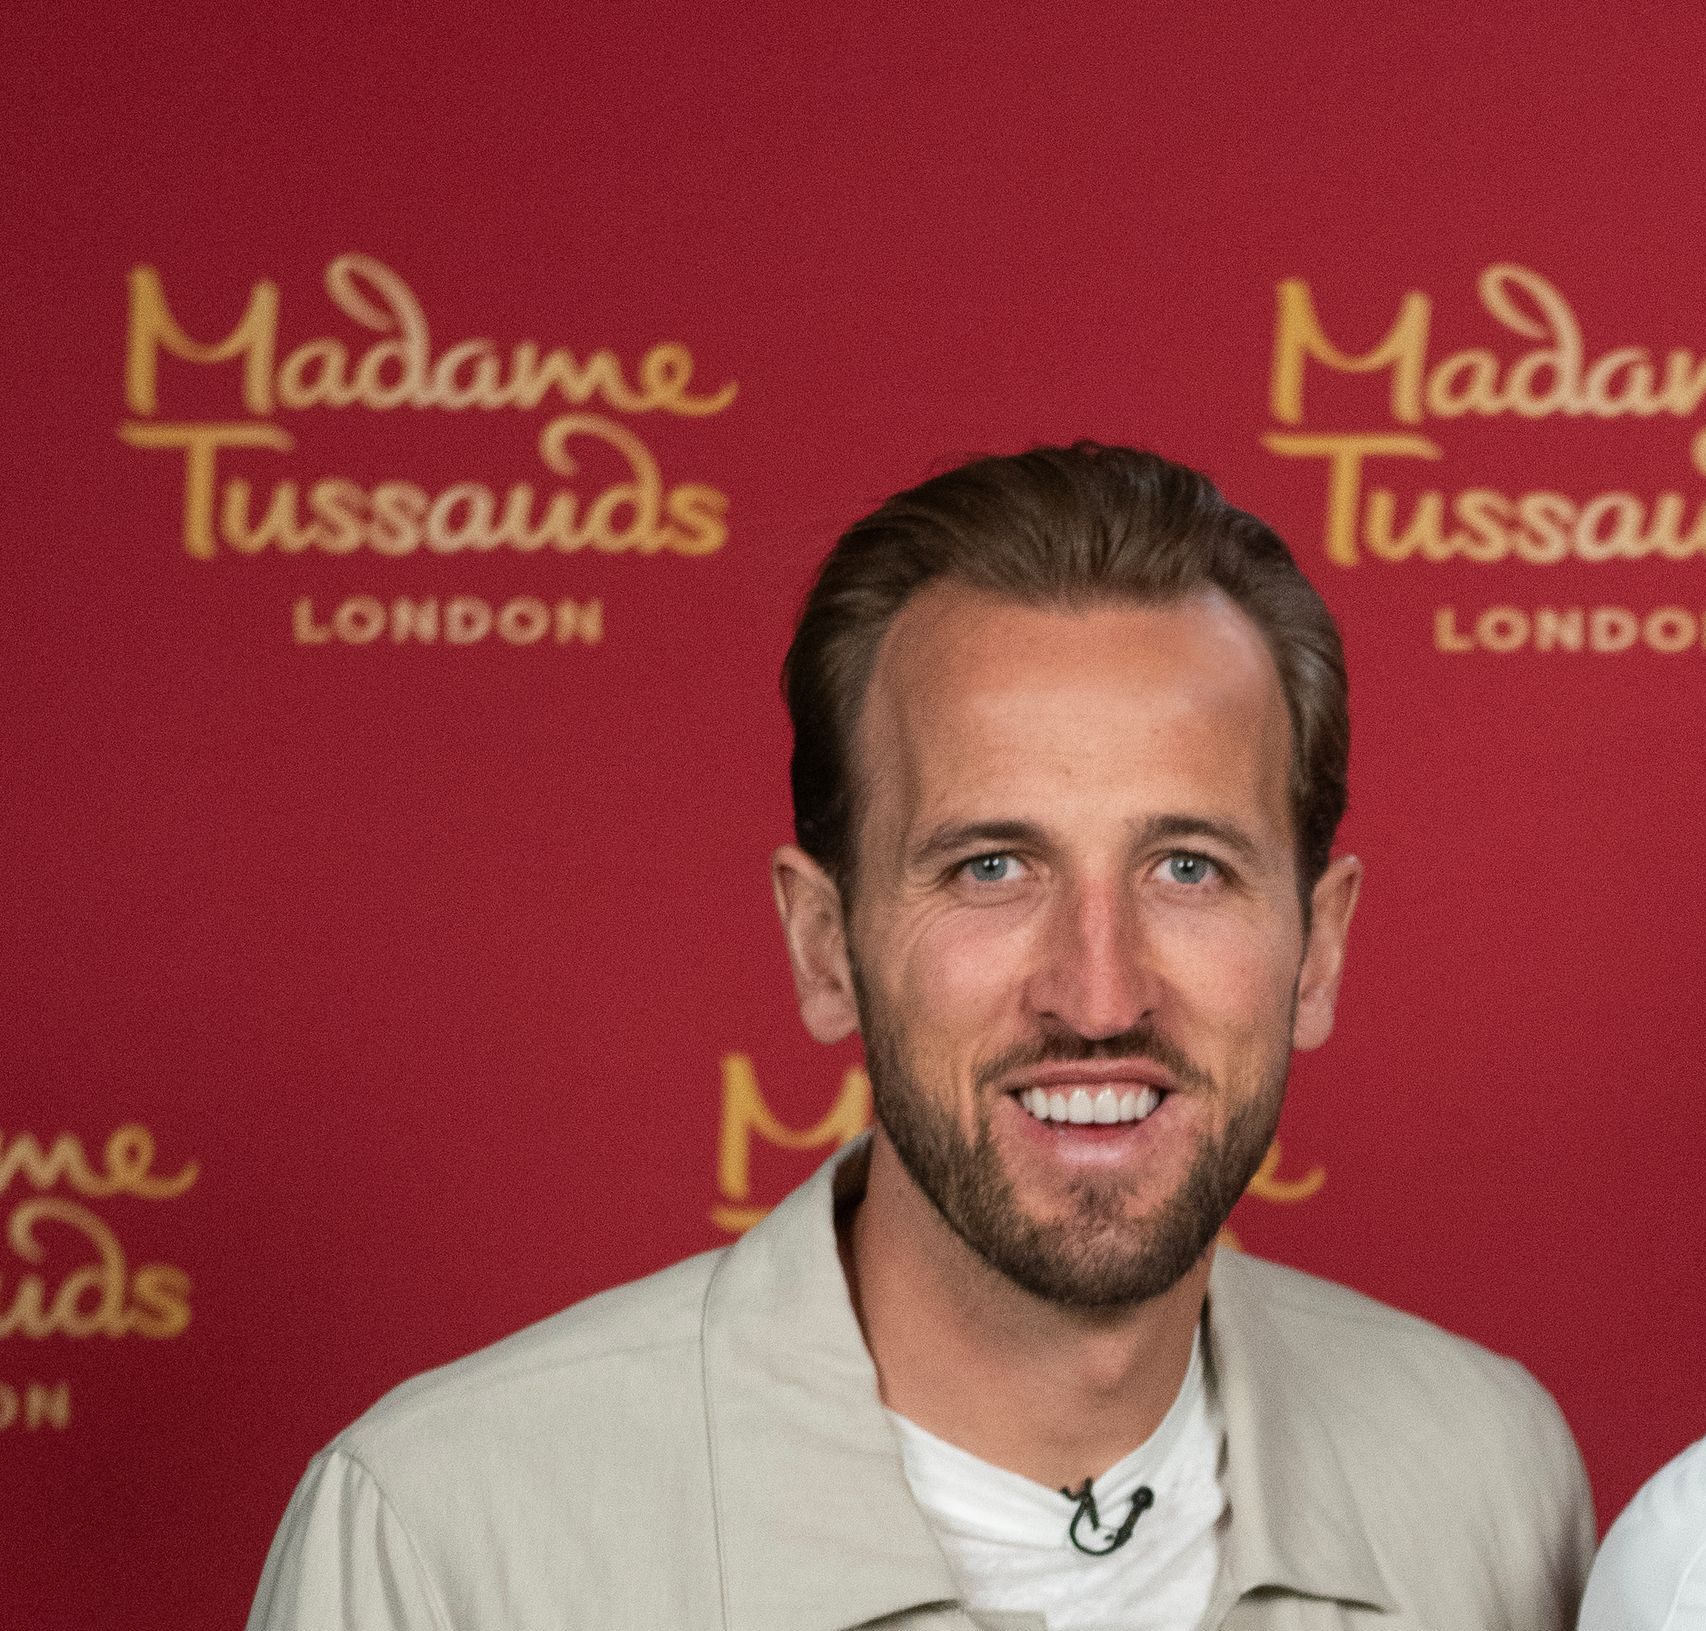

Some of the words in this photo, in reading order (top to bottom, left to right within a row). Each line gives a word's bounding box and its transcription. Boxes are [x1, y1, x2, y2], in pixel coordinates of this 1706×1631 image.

[124, 252, 738, 416] Madame
[119, 412, 729, 559] Tussauds
[292, 596, 604, 646] LONDON
